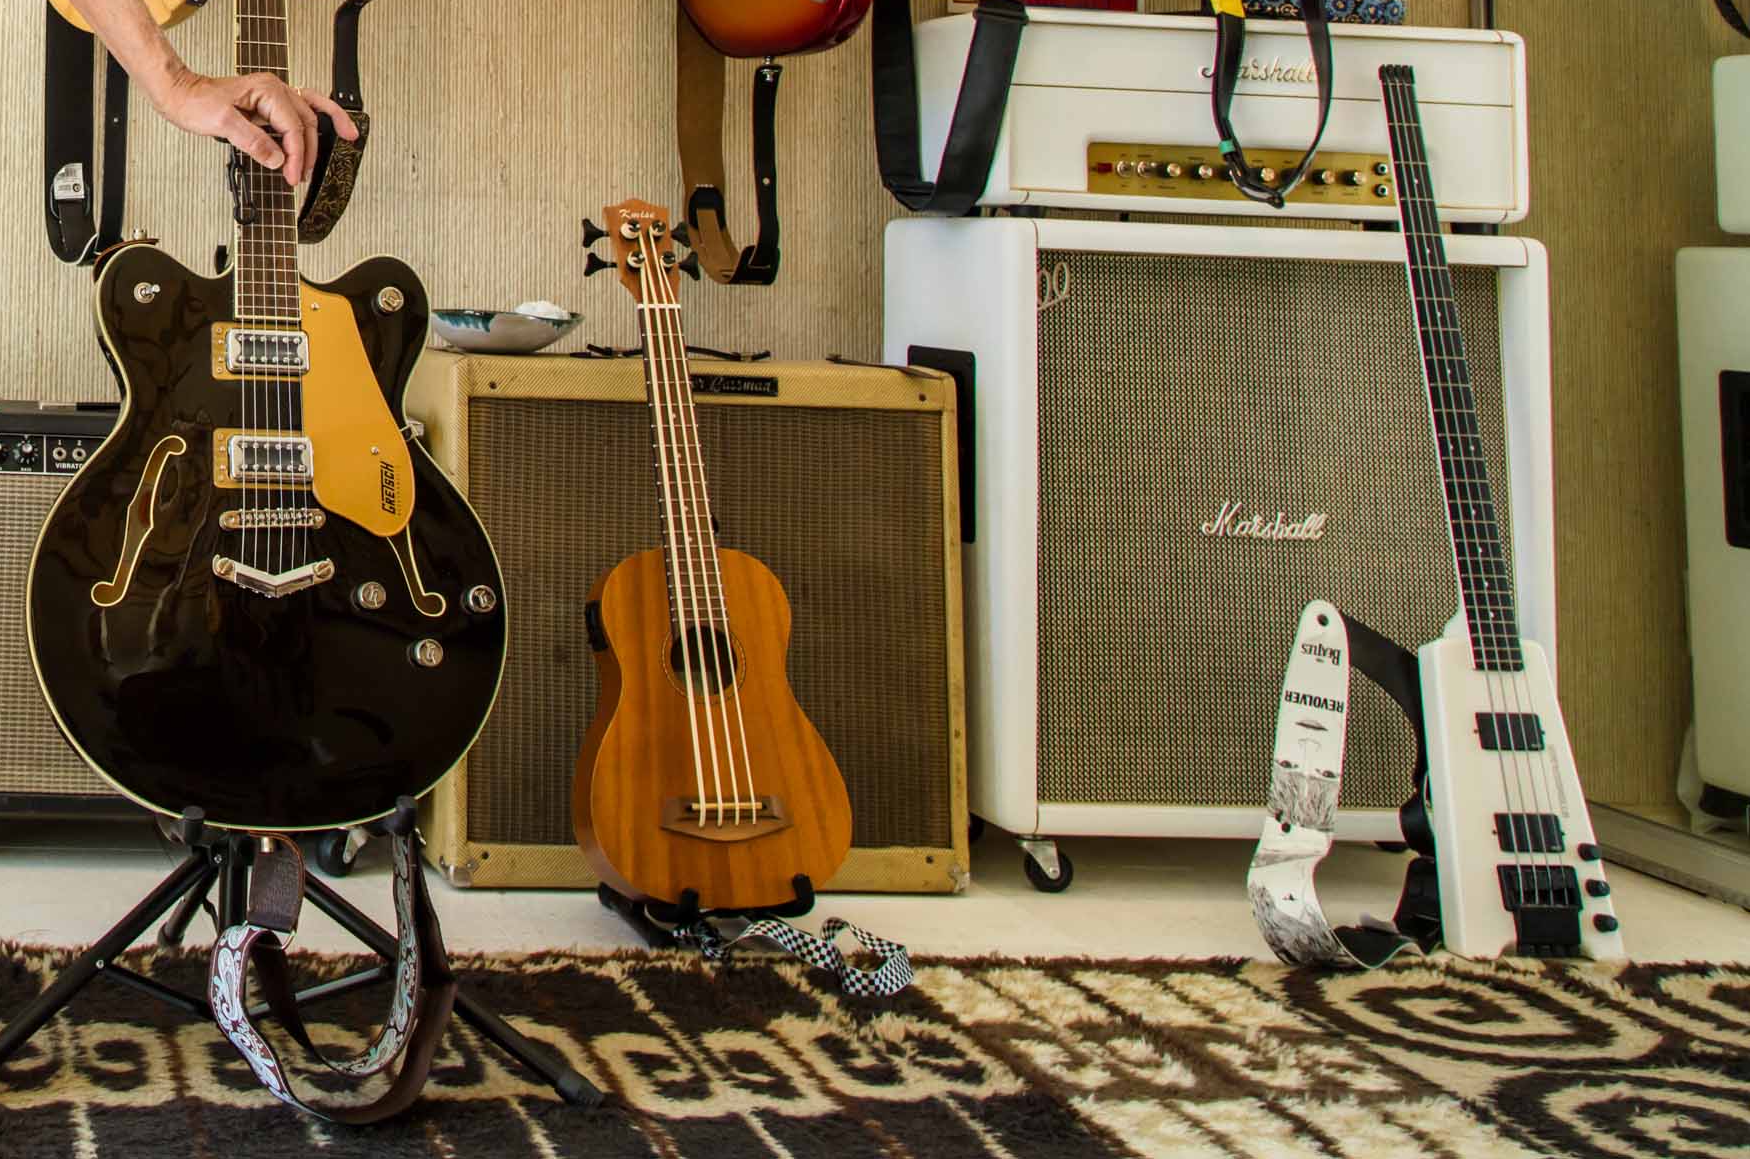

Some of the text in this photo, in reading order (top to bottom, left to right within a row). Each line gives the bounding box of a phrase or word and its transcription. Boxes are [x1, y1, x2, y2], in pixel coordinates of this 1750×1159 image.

[1197, 55, 1316, 83] arshall
[380, 461, 395, 515] GRETSCH
[1201, 501, 1329, 541] Marshall
[1284, 689, 1345, 713] REVOLVER
